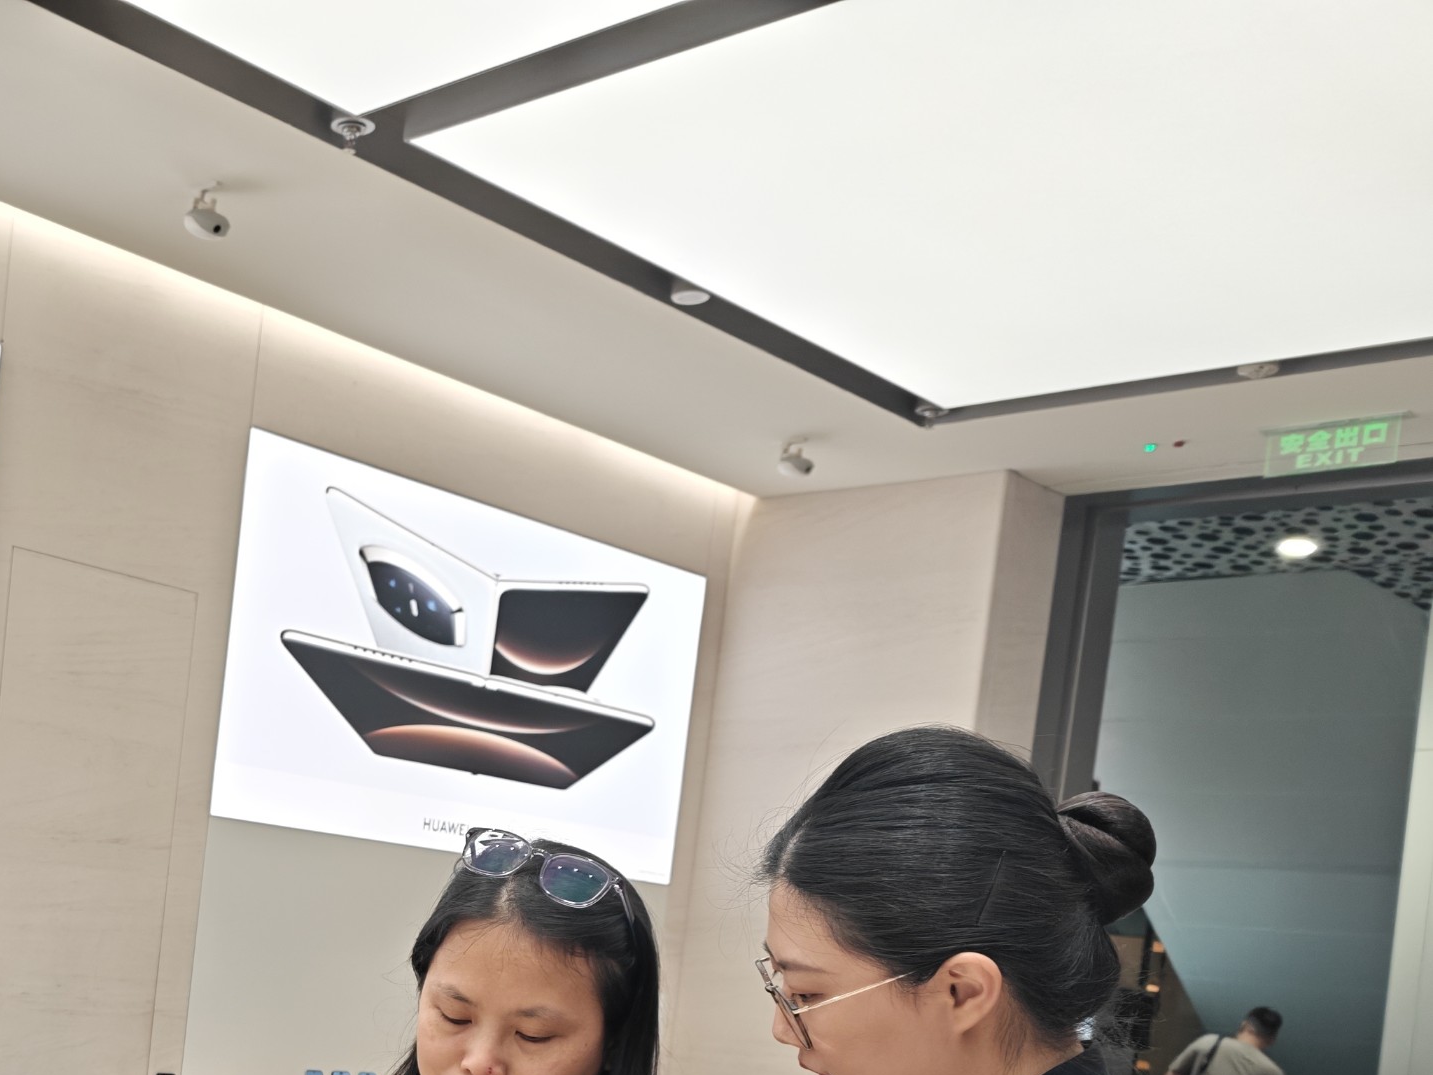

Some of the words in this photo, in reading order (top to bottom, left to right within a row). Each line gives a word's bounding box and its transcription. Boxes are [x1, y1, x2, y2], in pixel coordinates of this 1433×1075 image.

[1279, 423, 1388, 455] 安全出口
[1296, 447, 1365, 470] EXIT
